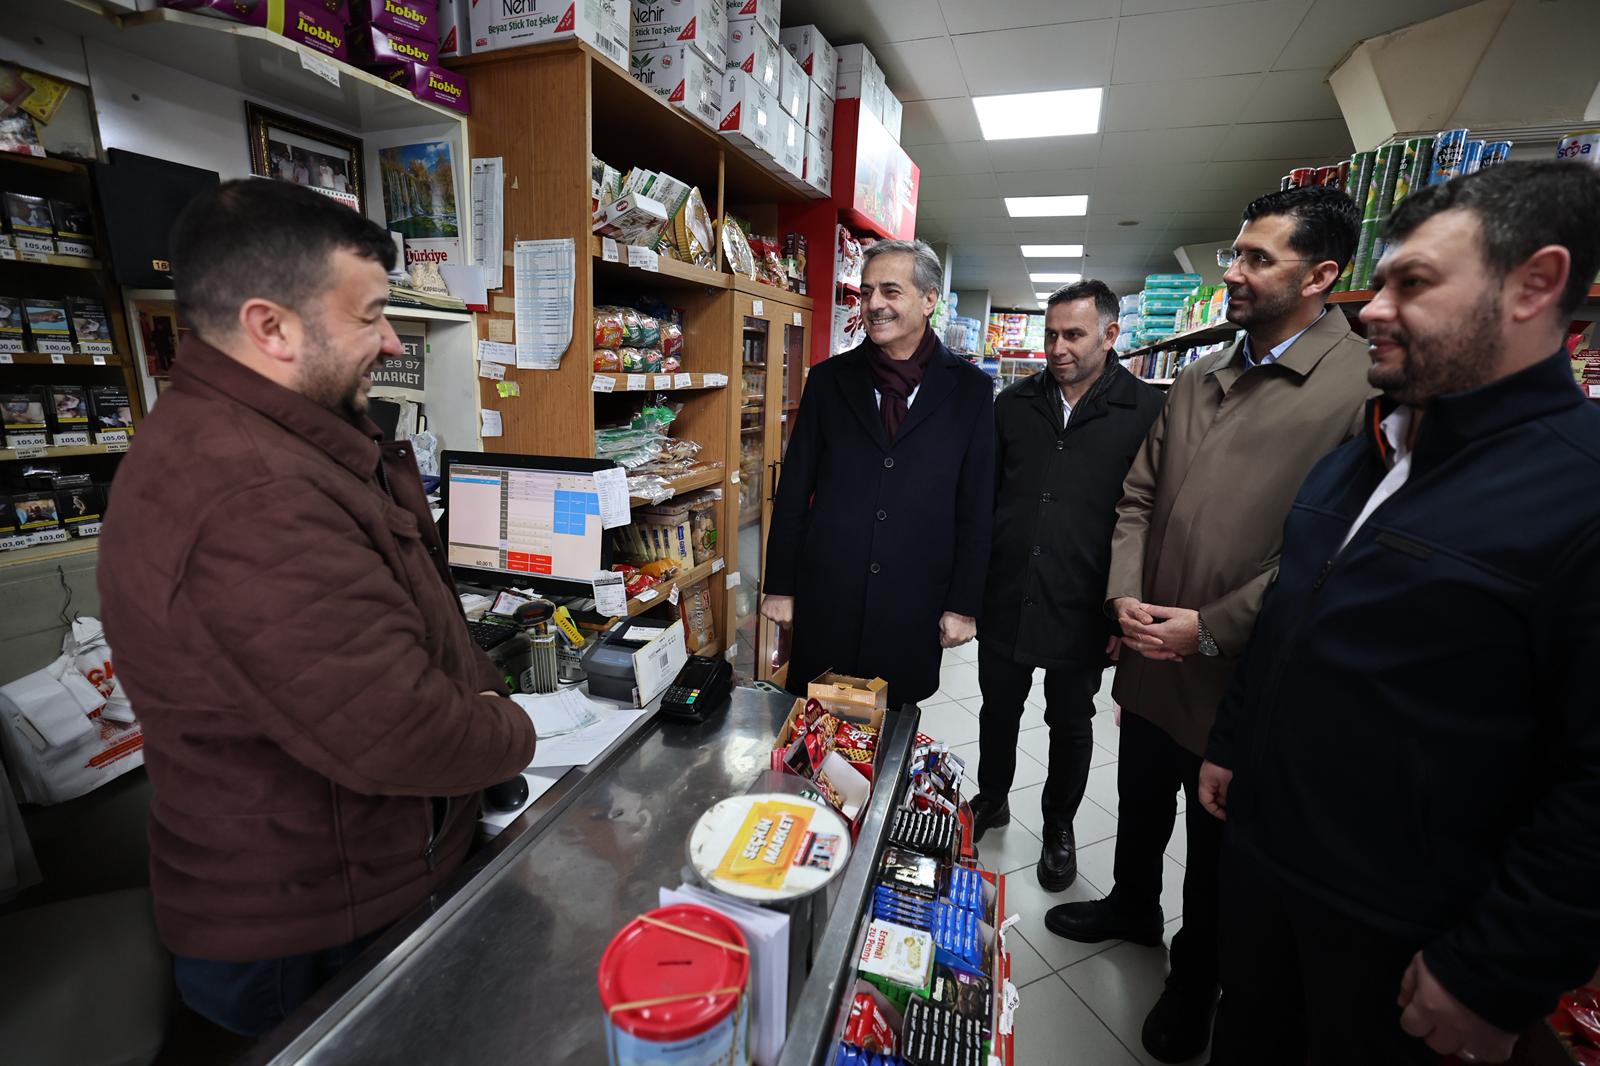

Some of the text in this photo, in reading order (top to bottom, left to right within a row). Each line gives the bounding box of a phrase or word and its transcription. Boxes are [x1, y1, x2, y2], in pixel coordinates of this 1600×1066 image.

[385, 0, 427, 25] hobby
[297, 18, 341, 48] hobby
[488, 15, 558, 34] Beyaz Stick Toz Şeker
[635, 25, 682, 36] Stick Toz Şeker
[388, 38, 429, 62] hobby
[428, 77, 462, 98] hobby
[24, 241, 52, 252] 105,00
[64, 245, 90, 255] 105,00
[405, 249, 448, 265] Türkiye
[156, 262, 168, 270] 16
[385, 359, 420, 370] 29 97
[370, 371, 420, 385] MARKET
[102, 434, 126, 442] 105,00
[39, 533, 65, 541] 103,00
[742, 817, 774, 861] SEÇKİN
[763, 813, 795, 864] MARKET
[861, 927, 876, 963] zu Penny
[874, 930, 888, 960] Erstmal
